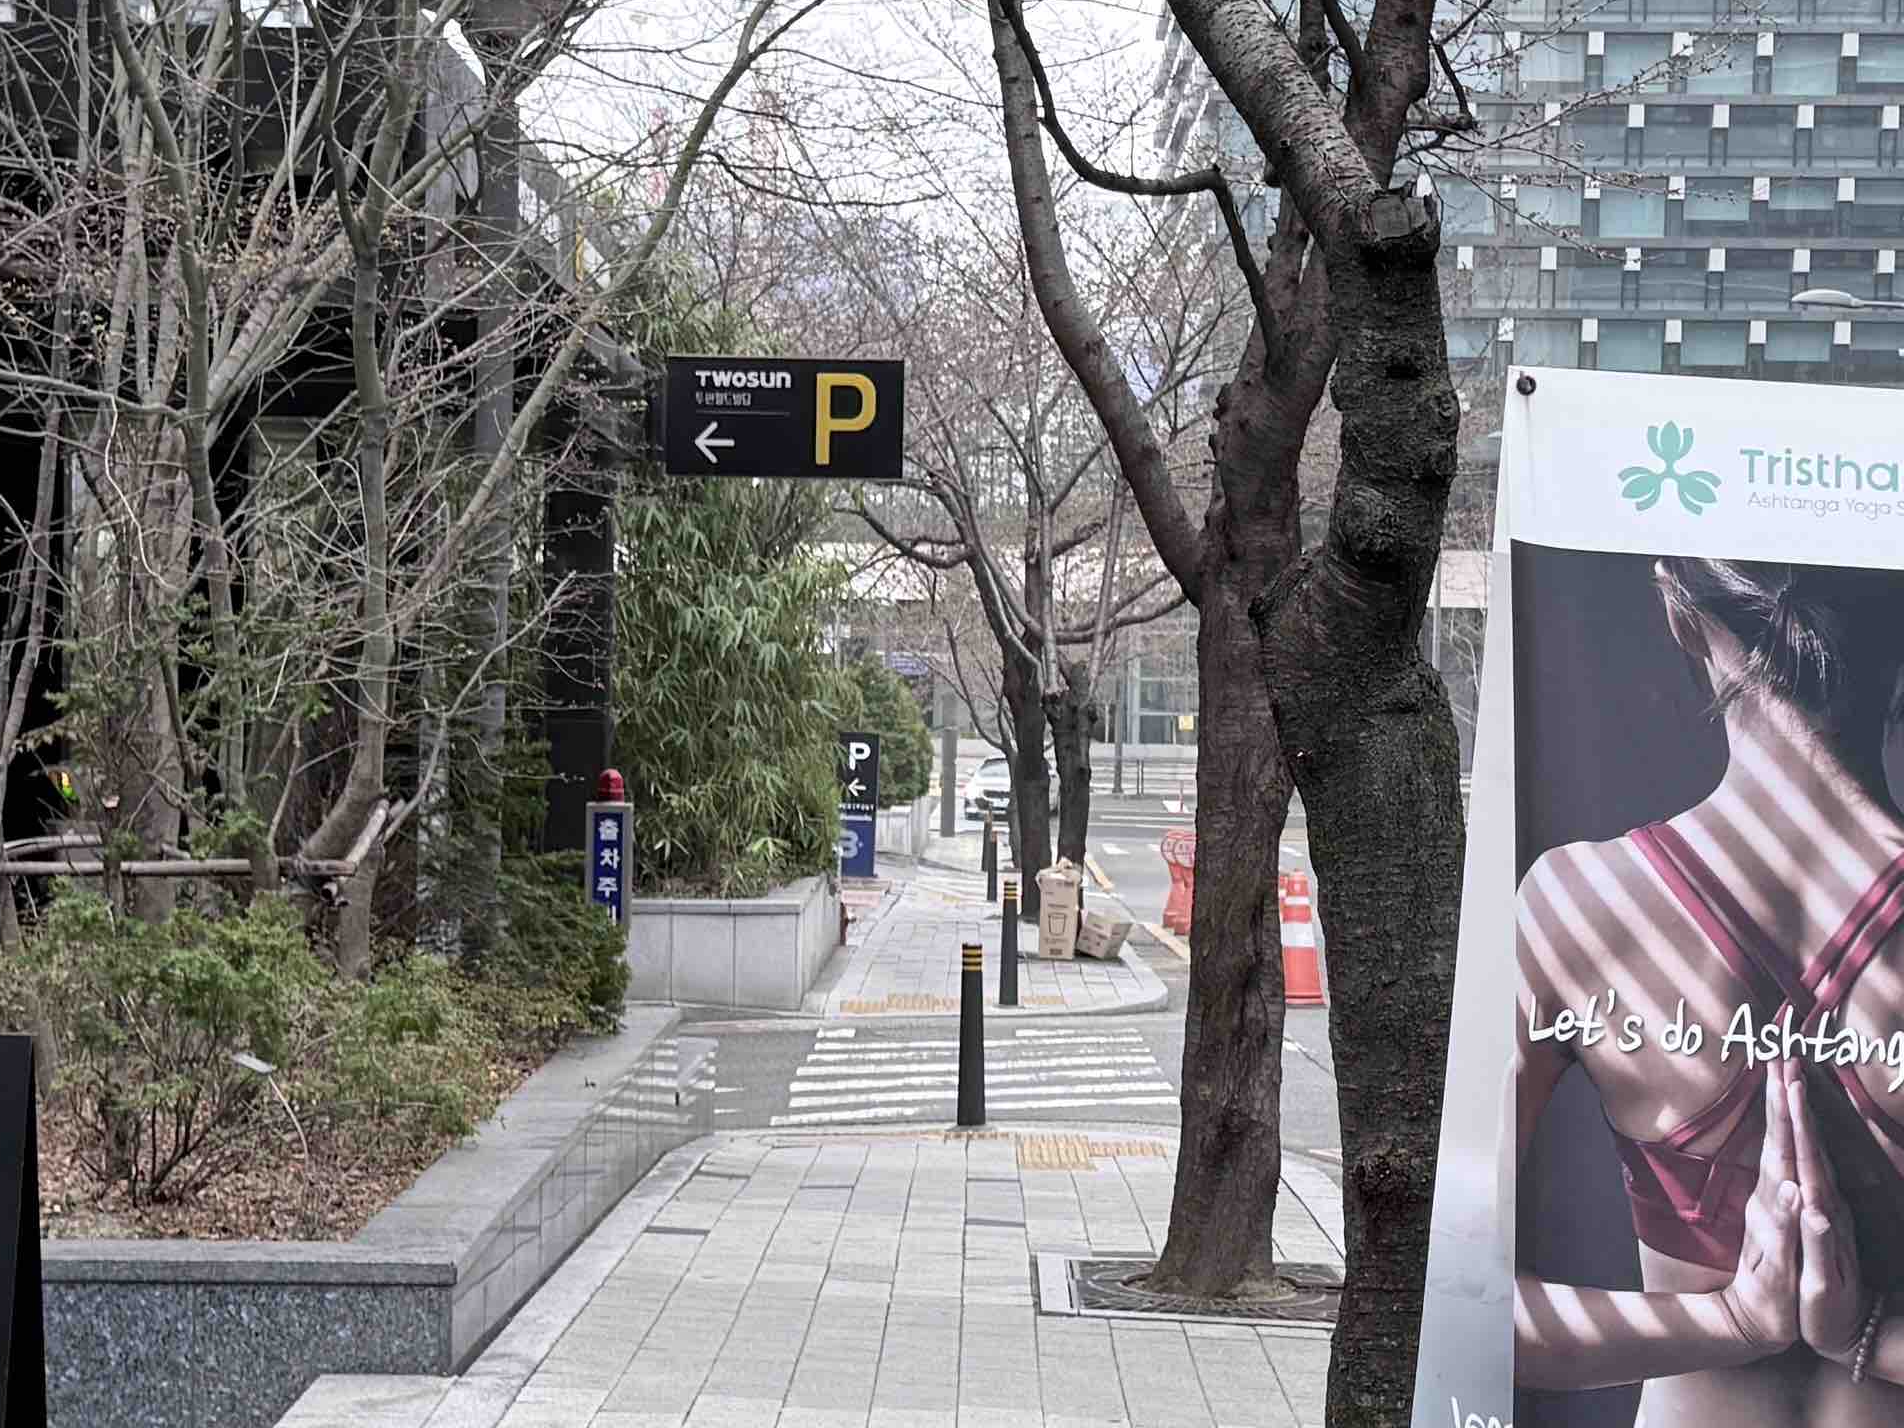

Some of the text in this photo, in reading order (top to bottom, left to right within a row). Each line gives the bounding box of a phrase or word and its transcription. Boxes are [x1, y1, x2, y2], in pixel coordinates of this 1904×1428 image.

[815, 372, 877, 466] P
[1747, 491, 1840, 518] Ashtanga
[1845, 498, 1892, 521] Yoga
[848, 741, 871, 771] P
[1528, 988, 1643, 1053] Let's
[1660, 997, 1703, 1056] do
